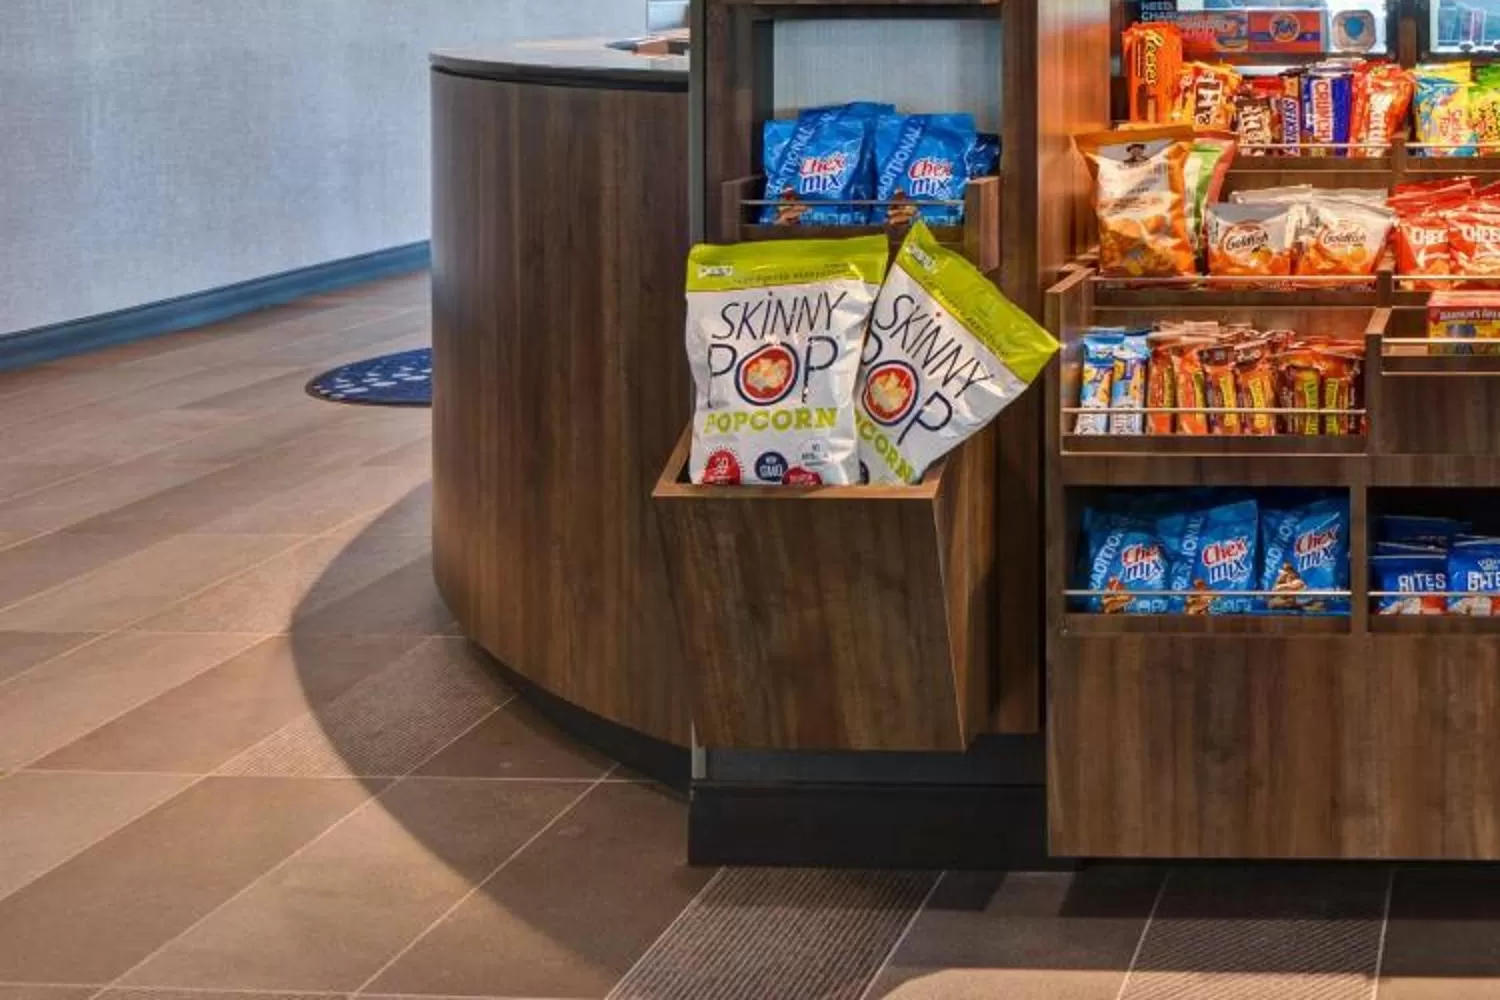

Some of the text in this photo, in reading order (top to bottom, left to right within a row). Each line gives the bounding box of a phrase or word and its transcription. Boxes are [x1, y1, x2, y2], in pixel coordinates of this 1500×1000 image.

[711, 291, 848, 341] SKINNY
[874, 294, 995, 399] SKINNY
[707, 335, 839, 409] POP
[704, 407, 838, 434] POPCORN
[1202, 537, 1249, 567] Chex
[1397, 572, 1447, 592] BITES
